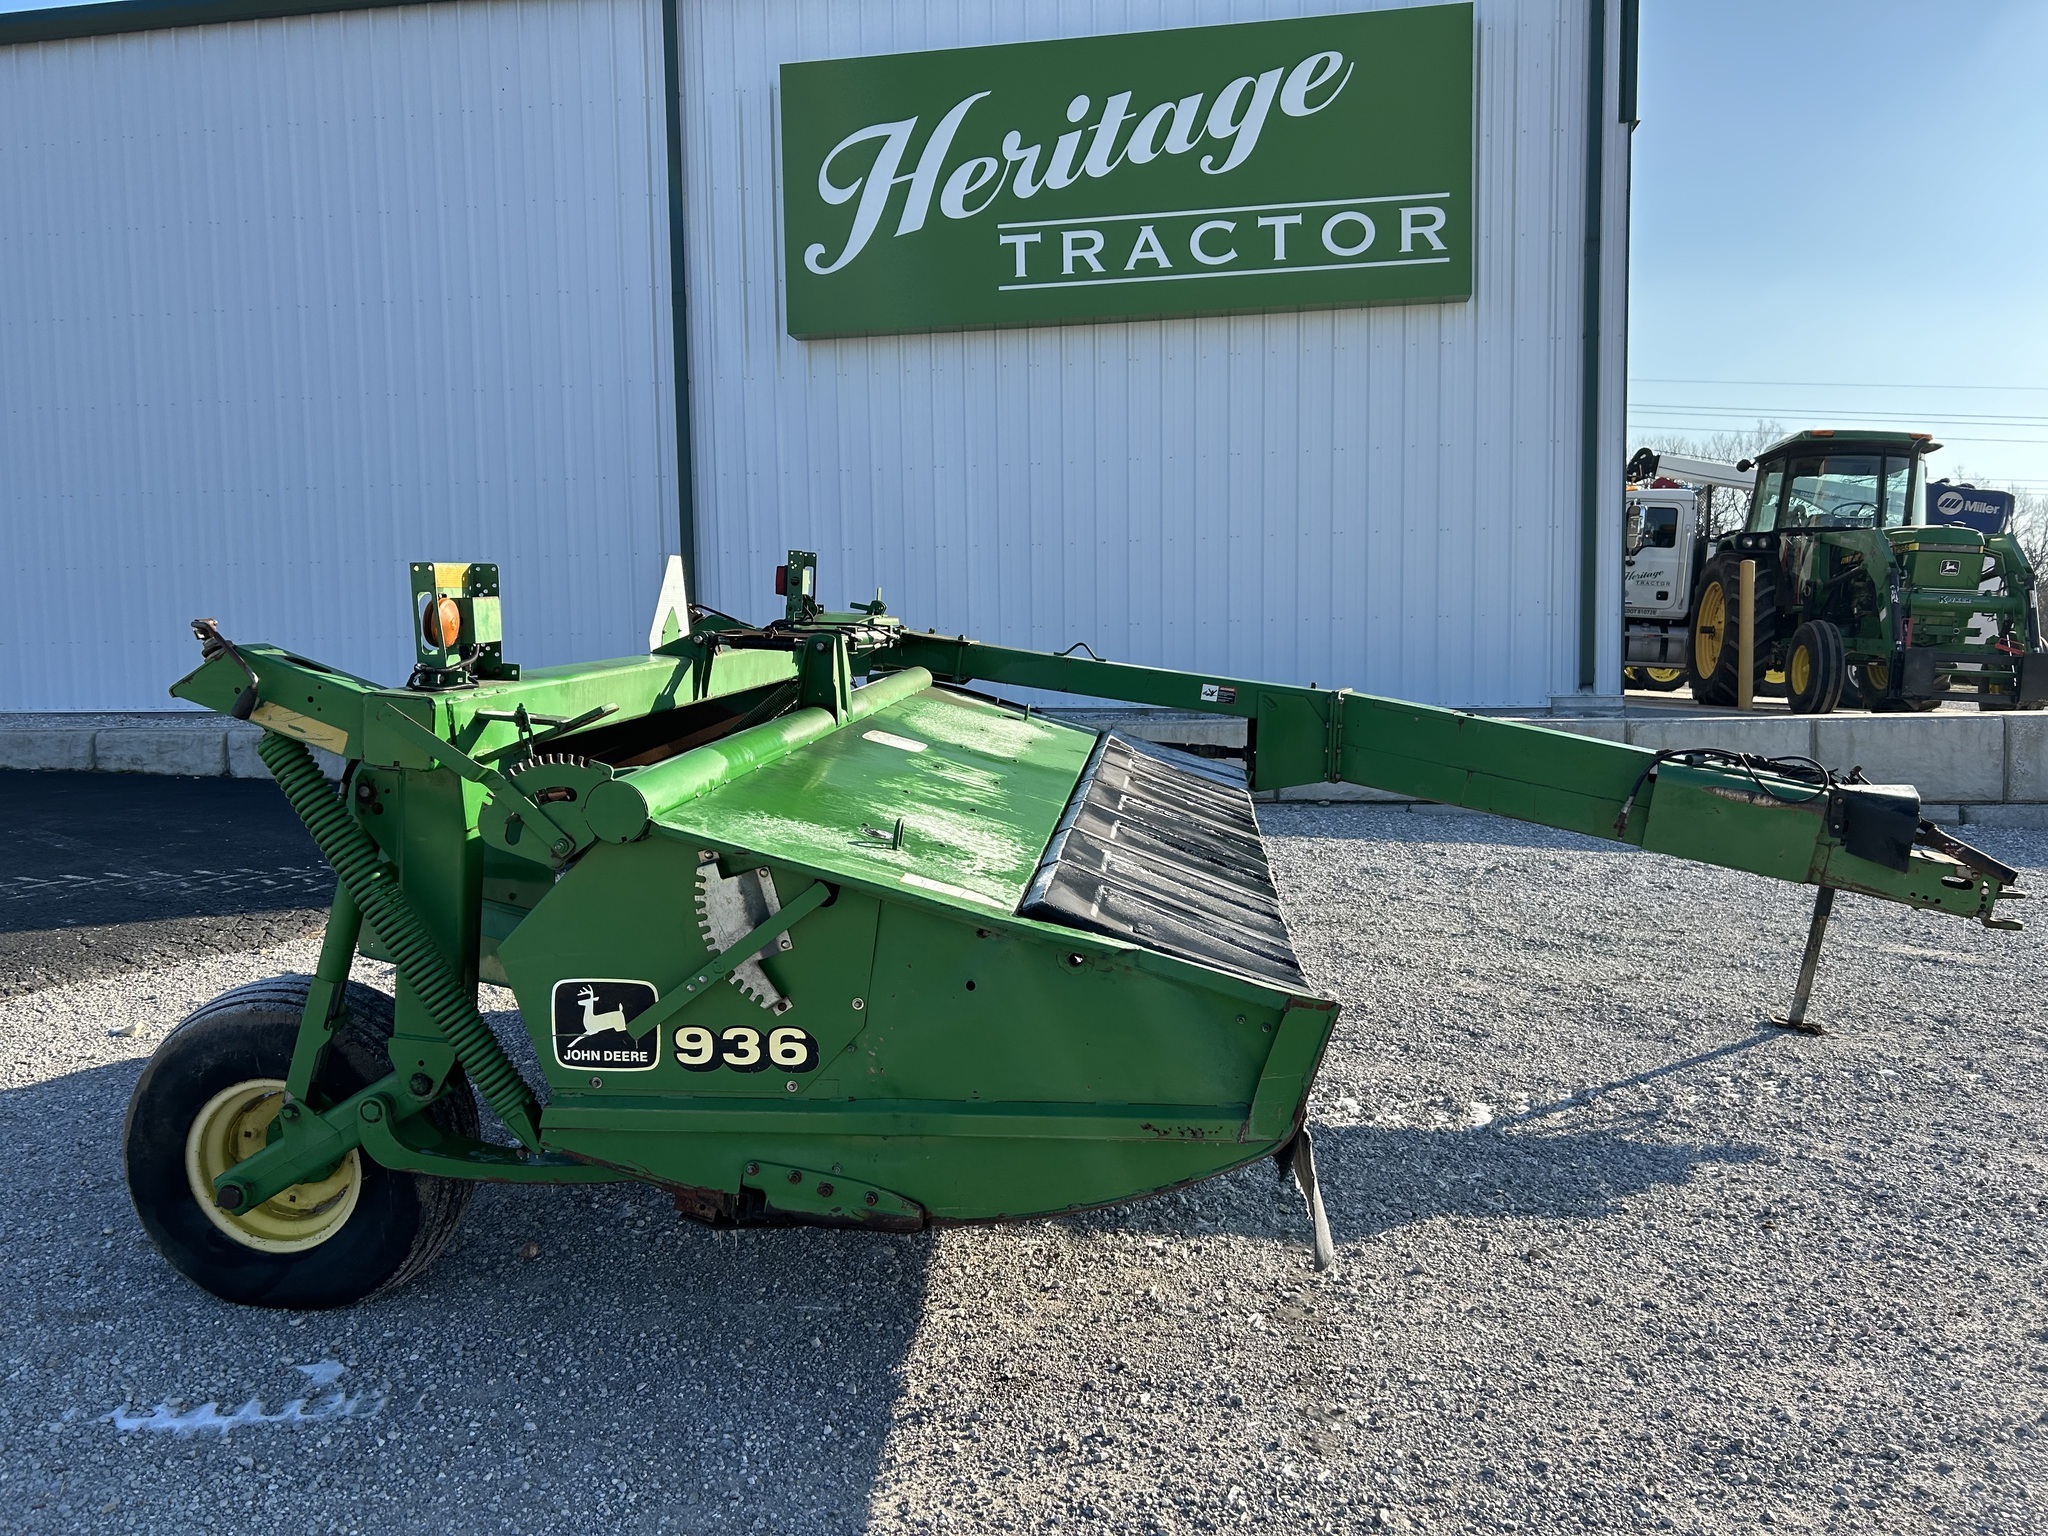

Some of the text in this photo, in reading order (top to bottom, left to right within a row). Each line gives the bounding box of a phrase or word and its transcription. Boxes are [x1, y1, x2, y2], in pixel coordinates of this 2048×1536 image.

[804, 49, 1355, 275] Heritage
[998, 206, 1449, 278] TRACTOR
[1964, 500, 2000, 514] Miller
[563, 1048, 649, 1063] JOHN DEERE
[674, 1026, 809, 1066] 936
